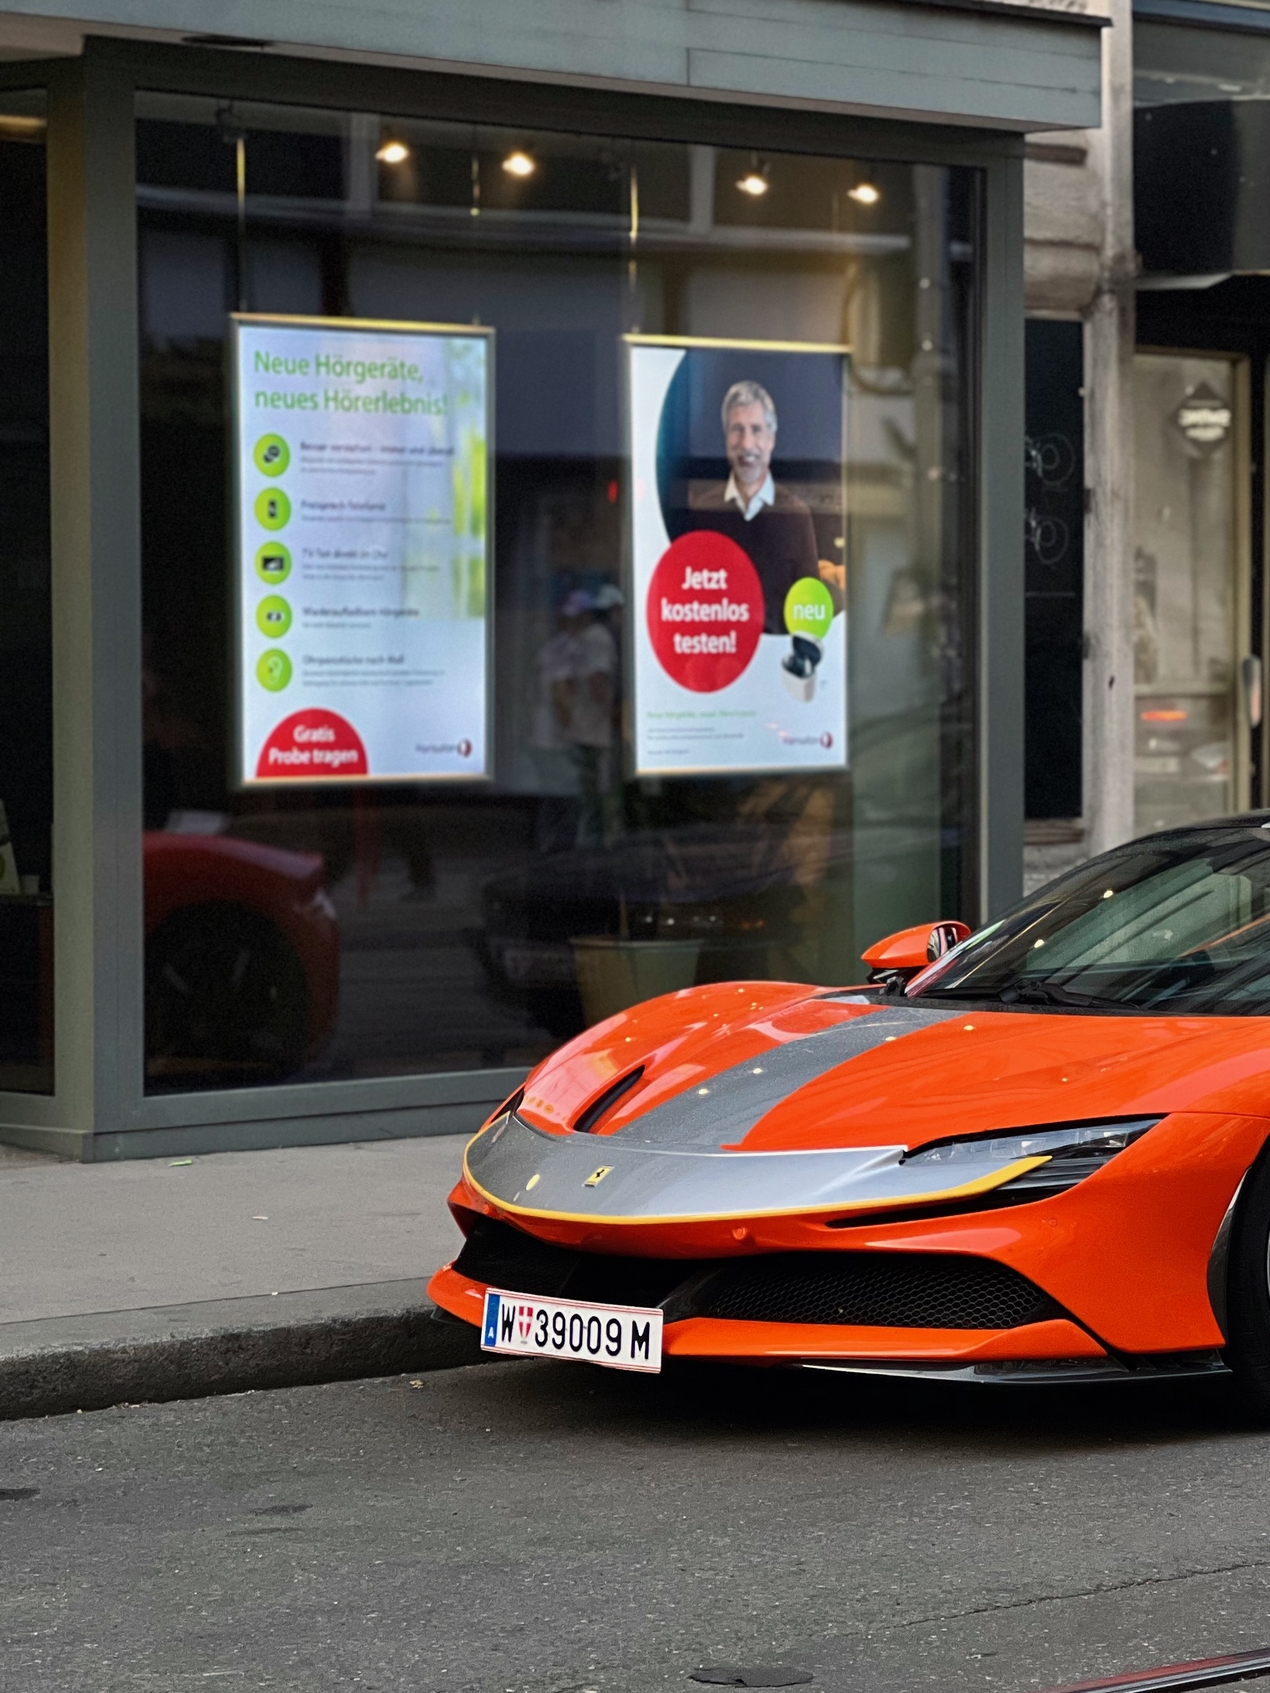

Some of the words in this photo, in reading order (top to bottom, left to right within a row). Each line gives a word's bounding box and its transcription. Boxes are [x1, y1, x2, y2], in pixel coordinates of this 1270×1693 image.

[254, 350, 310, 376] Neue
[315, 352, 423, 384] Hörgeräte,
[254, 391, 319, 411] neues
[681, 566, 728, 590] Jetzt
[660, 597, 750, 622] kostenlos
[792, 604, 826, 621] neu
[672, 630, 737, 655] testen!
[293, 724, 336, 743] Gratis
[268, 747, 311, 765] Probe
[312, 748, 358, 768] tragen
[501, 1303, 516, 1343] W
[534, 1309, 623, 1357] 39009
[630, 1320, 651, 1360] M
